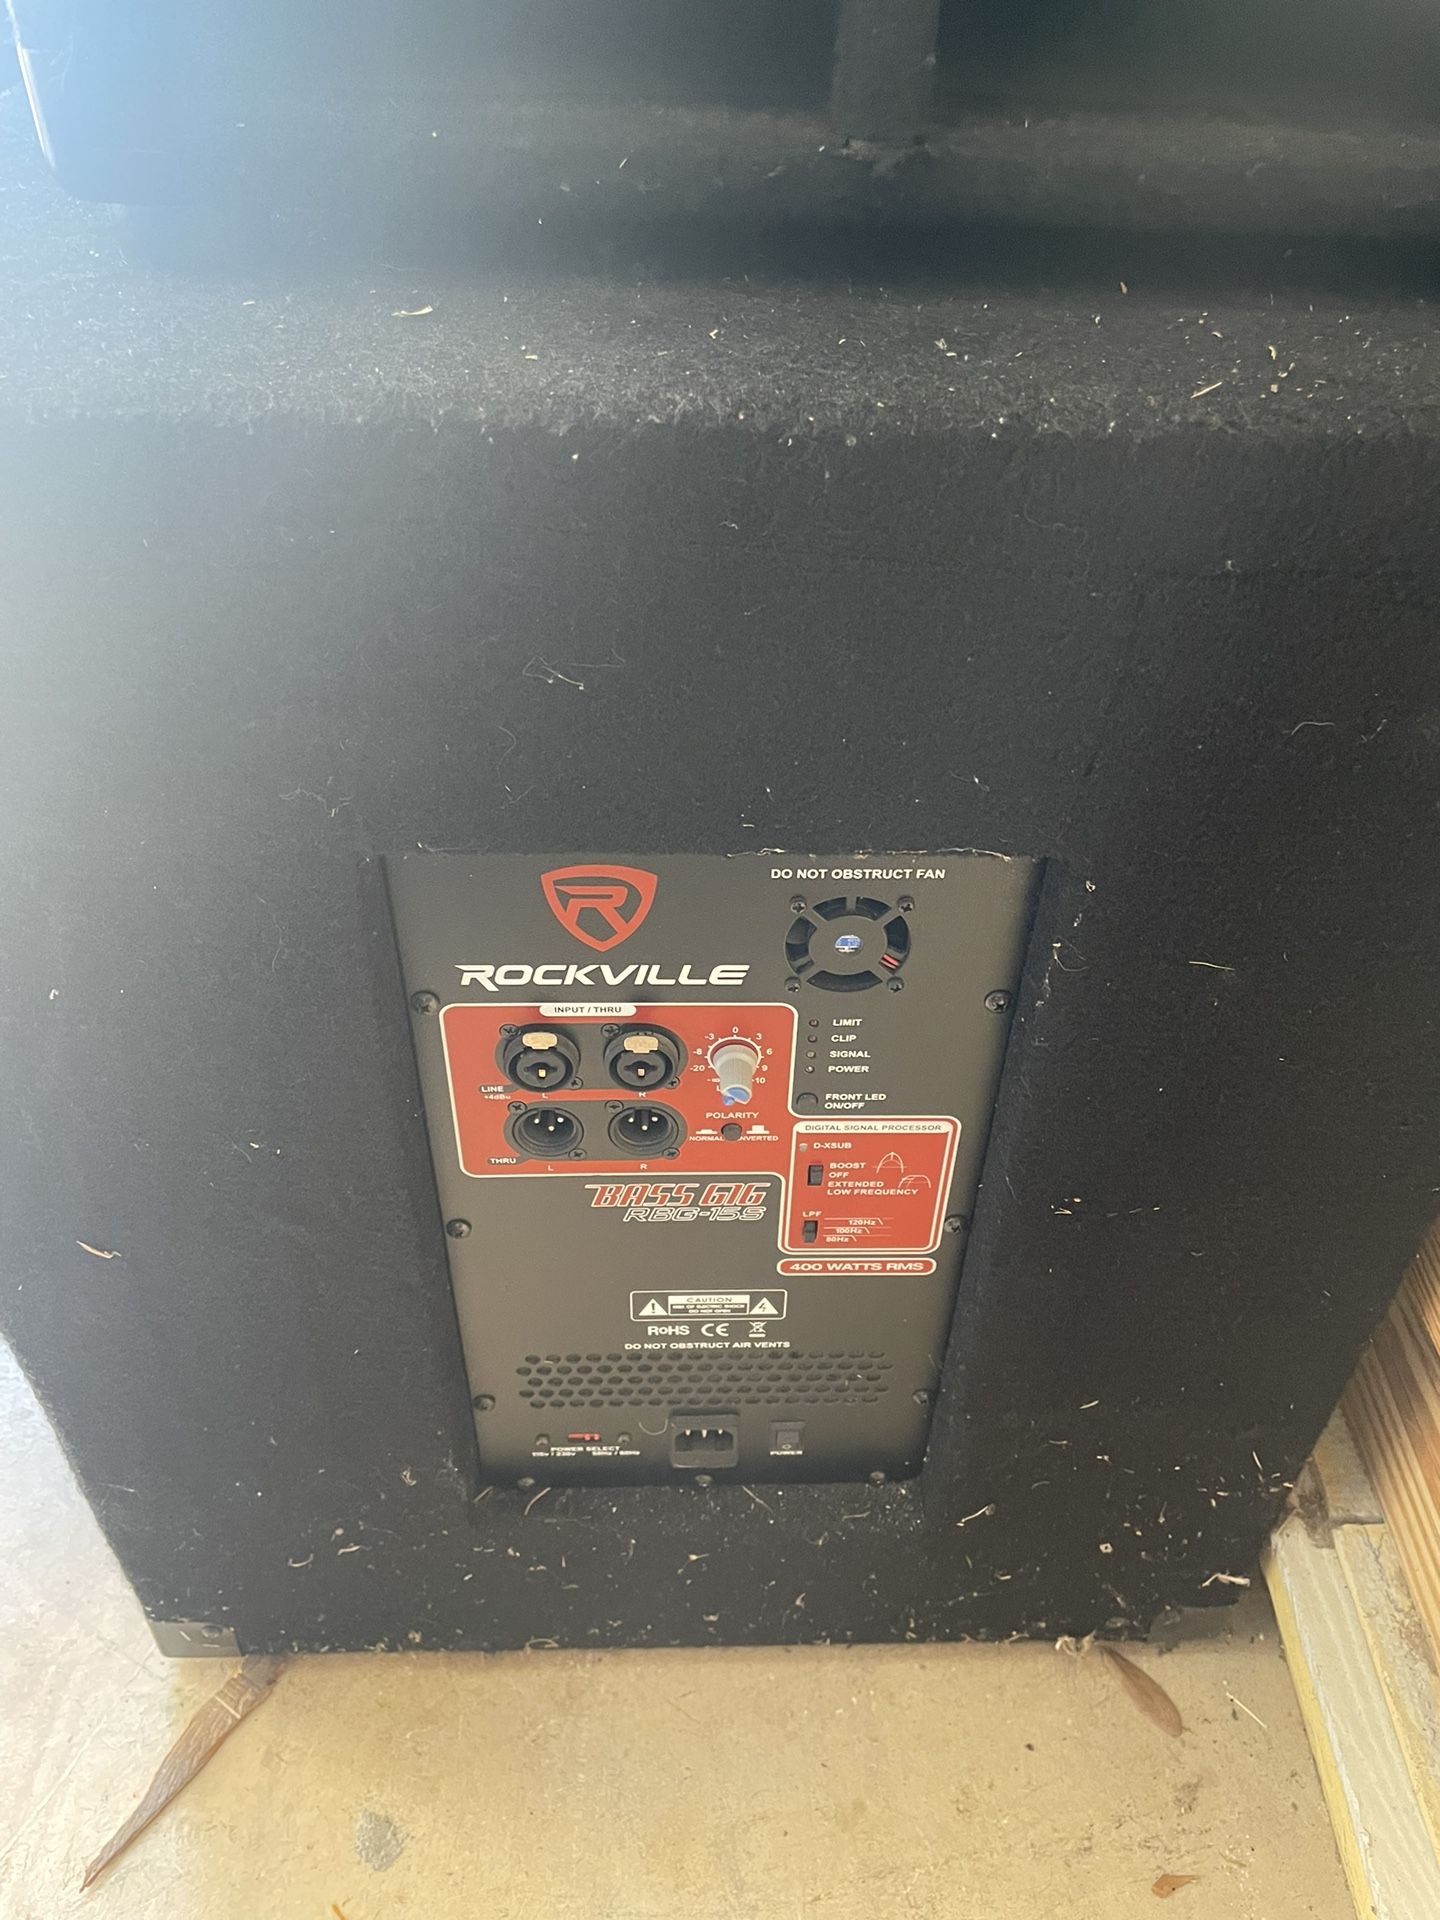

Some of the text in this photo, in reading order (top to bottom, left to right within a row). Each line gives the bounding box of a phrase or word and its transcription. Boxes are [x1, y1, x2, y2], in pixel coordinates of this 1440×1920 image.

[770, 868, 946, 880] DO NOT OBSTRUCT FAN
[454, 964, 750, 992] ROCKVILLE
[554, 1006, 622, 1014] INPUT / THRU
[832, 1018, 863, 1027] LIMIT
[732, 1026, 739, 1034] 0
[704, 1033, 715, 1041] -3
[755, 1033, 762, 1041] 3
[830, 1034, 857, 1043] CLIP
[766, 1048, 773, 1056] 6
[829, 1050, 871, 1059] SIGNAL
[689, 1064, 706, 1072] -20
[762, 1064, 769, 1072] 9
[827, 1065, 870, 1074] POWER
[481, 1085, 504, 1093] LINE
[825, 1093, 887, 1101] FRONT LED
[824, 1102, 865, 1110] ON/OFF
[705, 1111, 760, 1119] POLARITY
[805, 1124, 942, 1132] DIGITAL SIGNAL PROCESSOR
[813, 1141, 852, 1149] D-XSUB
[489, 1157, 517, 1165] THRU
[639, 1163, 648, 1171] R
[829, 1162, 867, 1170] BOOST
[828, 1171, 849, 1179] OFF
[584, 1183, 700, 1208] BASS
[853, 1188, 919, 1196] FREQUENCY
[622, 1206, 767, 1222] RBG-15S
[790, 1262, 925, 1272] 400 WATTS RMS
[686, 1296, 733, 1304] CAUTION
[647, 1325, 690, 1336] RoHS
[700, 1323, 730, 1337] CE
[753, 1341, 791, 1349] VENTS
